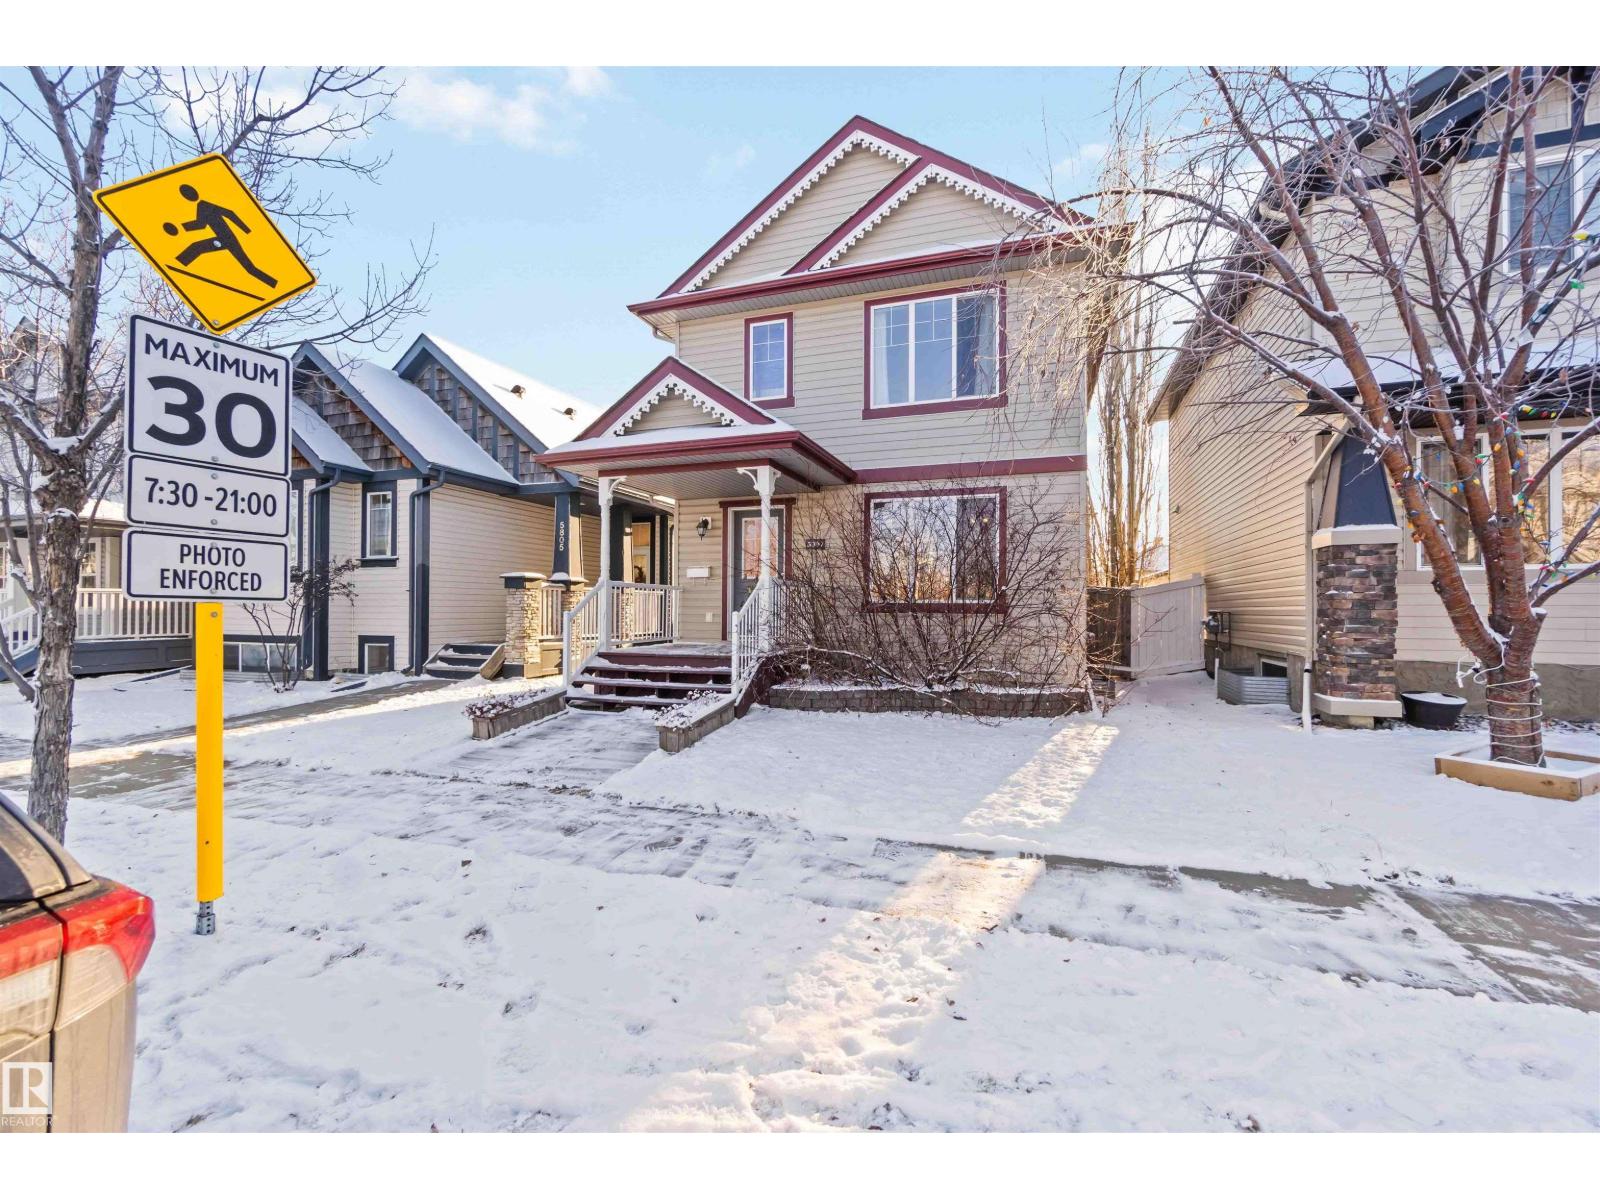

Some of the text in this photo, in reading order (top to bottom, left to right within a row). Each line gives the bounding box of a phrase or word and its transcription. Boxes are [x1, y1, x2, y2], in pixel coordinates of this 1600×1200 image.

[145, 333, 279, 387] MAXIMUM
[145, 375, 277, 459] 30
[144, 477, 198, 508] 7:30
[179, 544, 246, 567] PHOTO
[160, 568, 262, 592] ENFORCED
